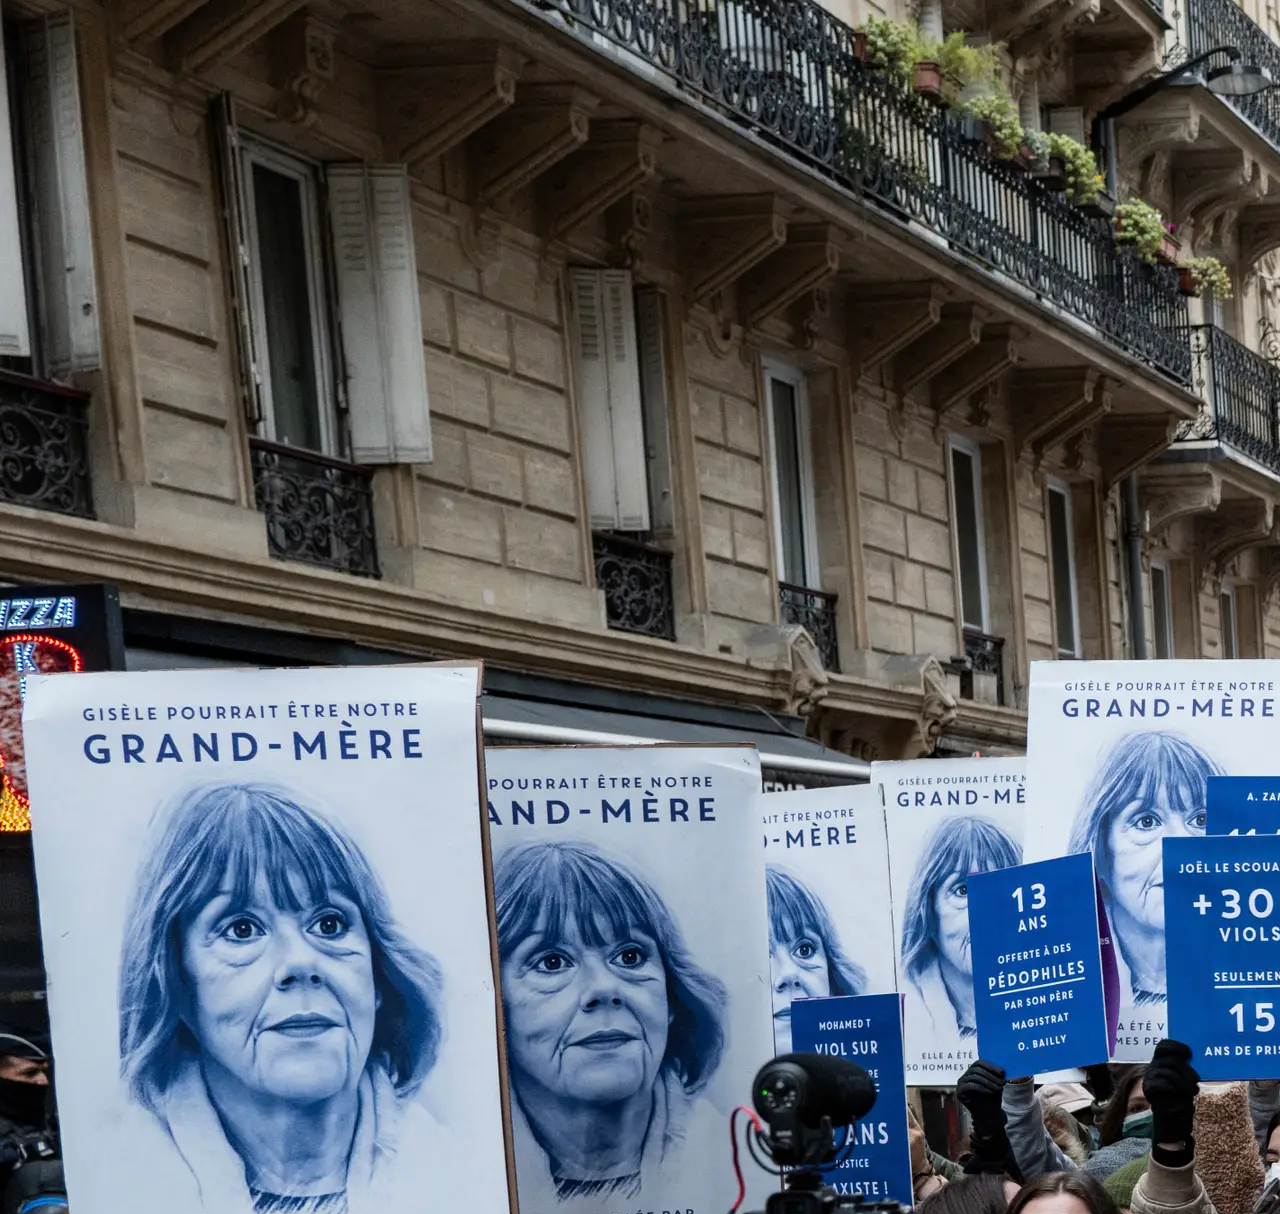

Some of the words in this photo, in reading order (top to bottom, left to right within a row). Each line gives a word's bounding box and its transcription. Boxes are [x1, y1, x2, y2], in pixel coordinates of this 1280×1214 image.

[1064, 680, 1110, 691] GISÈLE
[1117, 682, 1185, 691] POURRAIT
[1192, 680, 1223, 691] ÊTRE
[1229, 682, 1274, 691] NOTRE
[83, 704, 157, 721] GISÈLE
[167, 705, 278, 720] POURRAIT
[288, 701, 338, 718] ÊTRE
[348, 702, 418, 717] NOTRE
[1062, 692, 1275, 718] GRAND-MÈRE
[84, 720, 423, 764] GRAND-MÈRE
[489, 778, 589, 790] POURRAIT
[598, 774, 642, 788] ÊTRE
[651, 776, 713, 788] NOTRE
[1247, 793, 1258, 801] A.
[1179, 860, 1210, 874] JOËL
[1215, 863, 1229, 873] LE
[1011, 883, 1047, 913] 13
[1018, 915, 1047, 933] ANS
[1219, 926, 1280, 942] VIOLS
[997, 949, 1041, 965] OFFERTE
[1044, 945, 1050, 957] À
[1053, 943, 1072, 955] DES
[988, 960, 1085, 990] PÉDOPHILES
[1004, 999, 1023, 1010] PAR
[1026, 995, 1046, 1007] SON
[1049, 989, 1074, 1003] PÈRE
[819, 1019, 864, 1031] MOHAMED
[866, 1018, 871, 1028] T
[1012, 1012, 1069, 1031] MAGISTRAT
[1228, 1002, 1276, 1032] 15
[815, 1042, 848, 1057] VIOL
[852, 1040, 878, 1055] SUR
[1018, 1040, 1029, 1051] O.
[1032, 1034, 1067, 1049] BAILLY
[1205, 1046, 1230, 1056] ANS
[1235, 1046, 1251, 1056] DE
